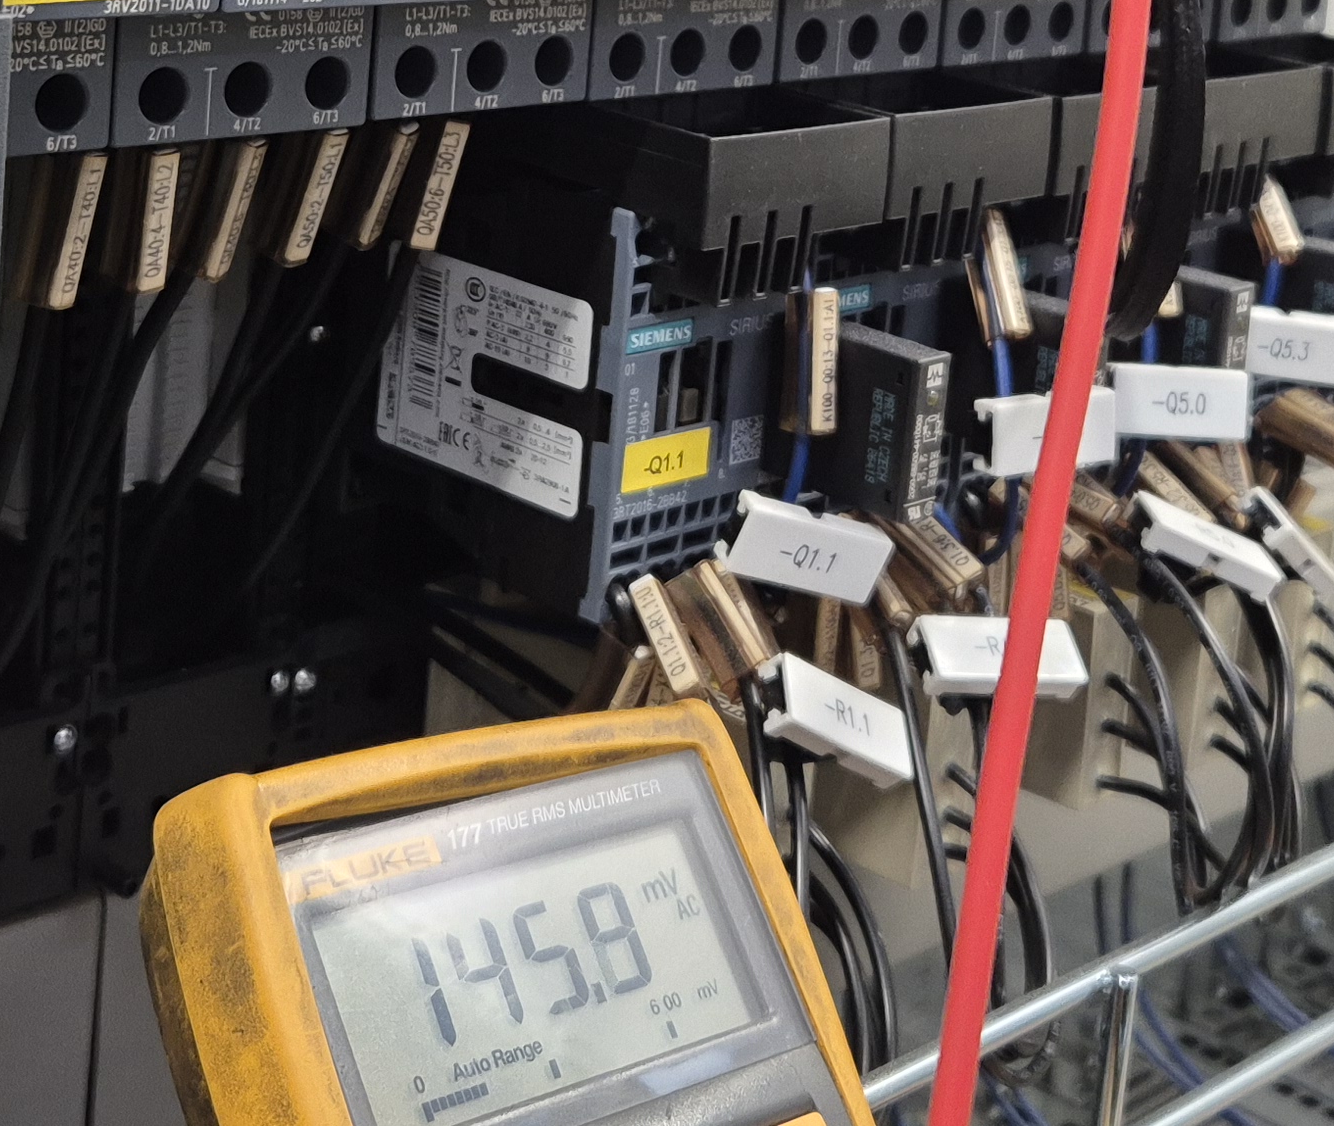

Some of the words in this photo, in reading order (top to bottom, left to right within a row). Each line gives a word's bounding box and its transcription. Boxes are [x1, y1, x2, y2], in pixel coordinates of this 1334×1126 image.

[402, 101, 428, 117] 2/T1
[474, 94, 500, 110] 4/T2
[541, 88, 566, 103] 6/T3
[45, 135, 79, 152] 6/T3
[148, 125, 177, 142] 2/T1
[233, 117, 262, 133] 4/T2
[312, 109, 340, 125] 6/T3
[630, 324, 692, 348] SIEMENS
[1256, 340, 1311, 362] -Q5.3
[1151, 391, 1207, 417] -Q5.0
[643, 452, 685, 476] -Q1.1
[779, 543, 839, 574] -Q1.1
[823, 697, 873, 738] -R1.1
[446, 821, 484, 851] 177
[486, 810, 532, 838] TRUE
[530, 802, 566, 829] RMS
[567, 778, 662, 820] MULTIMETER
[299, 839, 431, 898] FLUKE
[641, 868, 681, 904] mV
[676, 894, 702, 923] AC
[411, 879, 653, 1049] 145.8
[697, 978, 721, 1001] mV
[451, 1054, 492, 1084] Auto
[491, 1035, 545, 1075] Range
[412, 1075, 426, 1094] 0
